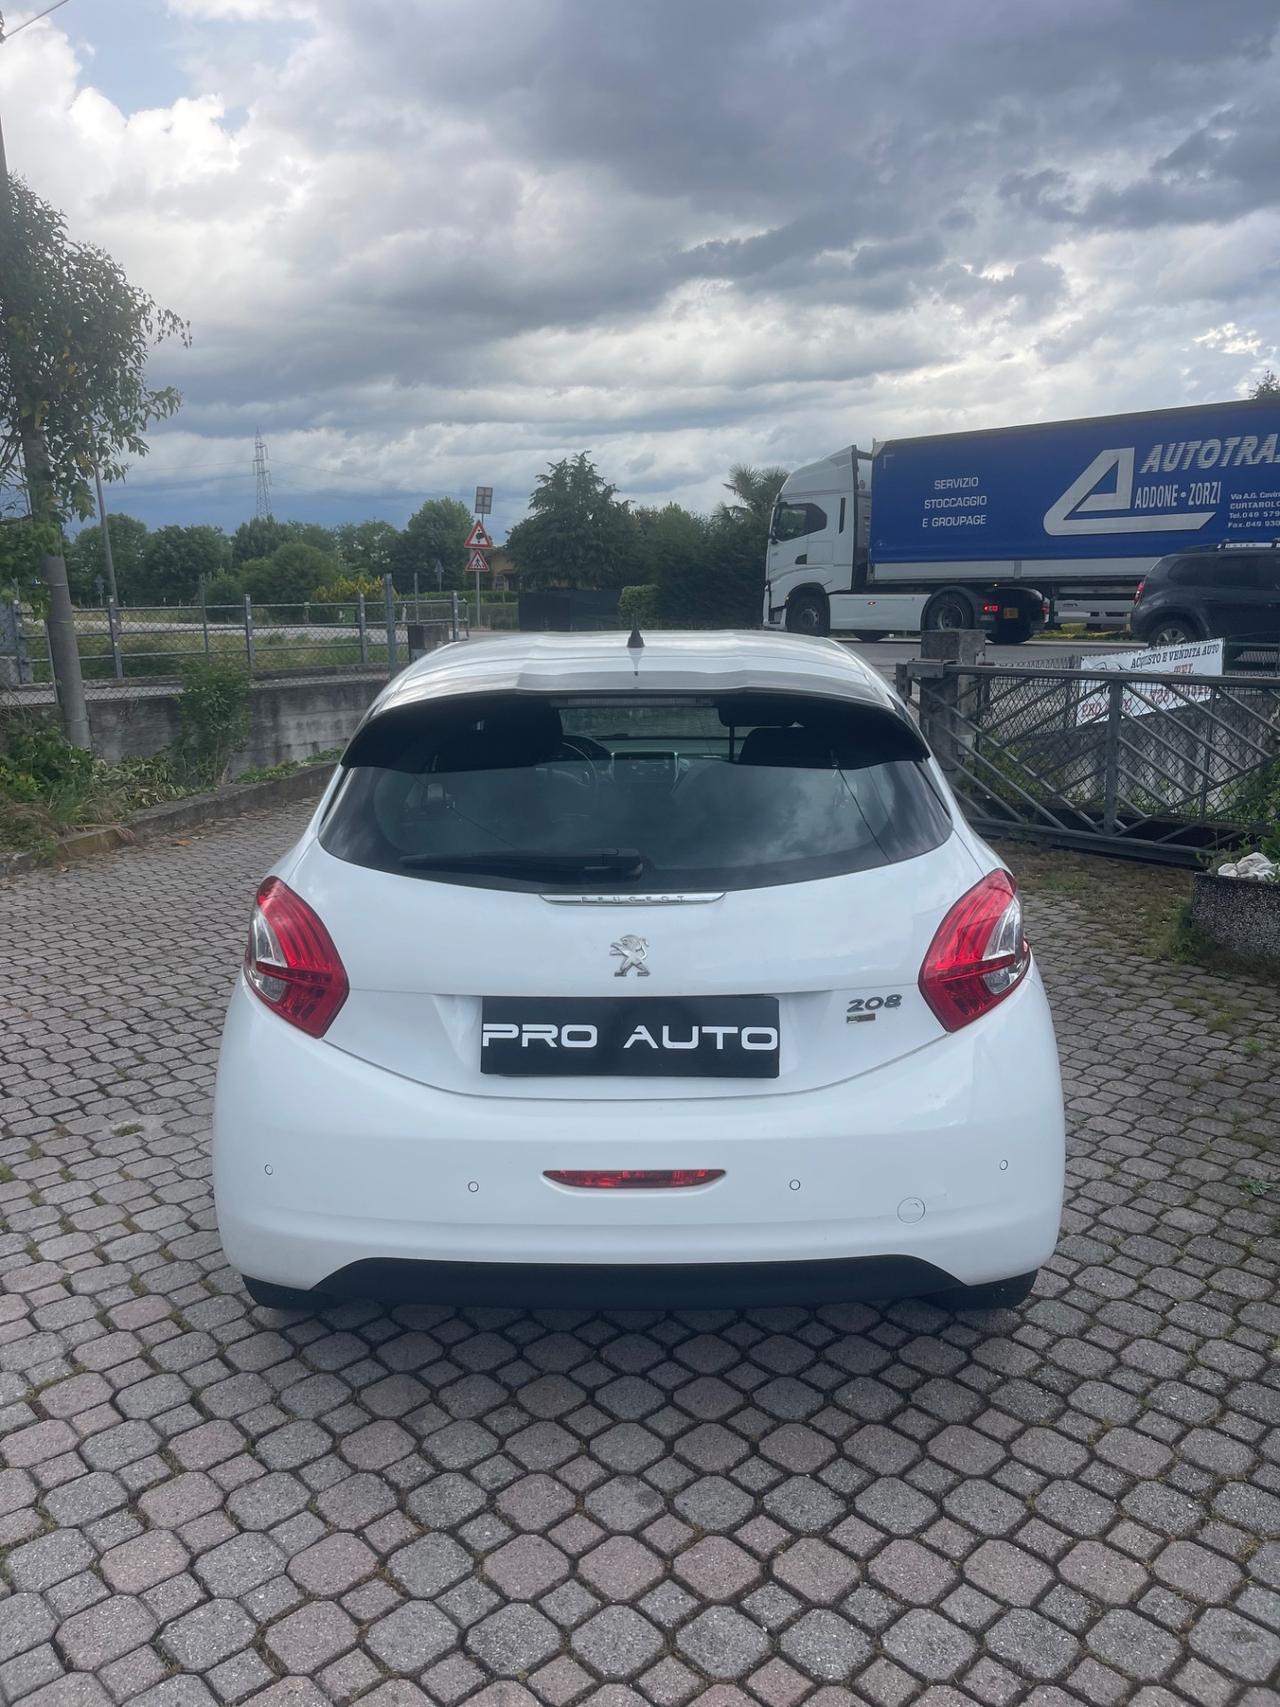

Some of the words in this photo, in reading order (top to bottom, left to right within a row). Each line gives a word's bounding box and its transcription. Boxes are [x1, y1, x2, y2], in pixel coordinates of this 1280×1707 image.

[1139, 433, 1280, 474] AUTOTRA
[934, 477, 979, 490] SERVIZIO
[924, 495, 987, 509] STOCCAGGIO
[1135, 484, 1179, 509] ADDONE
[1188, 481, 1221, 506] ZORZI
[922, 518, 929, 528] E
[931, 515, 987, 527] GROUPAGE
[1162, 651, 1168, 662] E
[1169, 647, 1200, 661] VENDITA
[846, 994, 903, 1013] 208
[482, 1023, 598, 1048] PRO
[623, 1025, 778, 1050] AUTO
